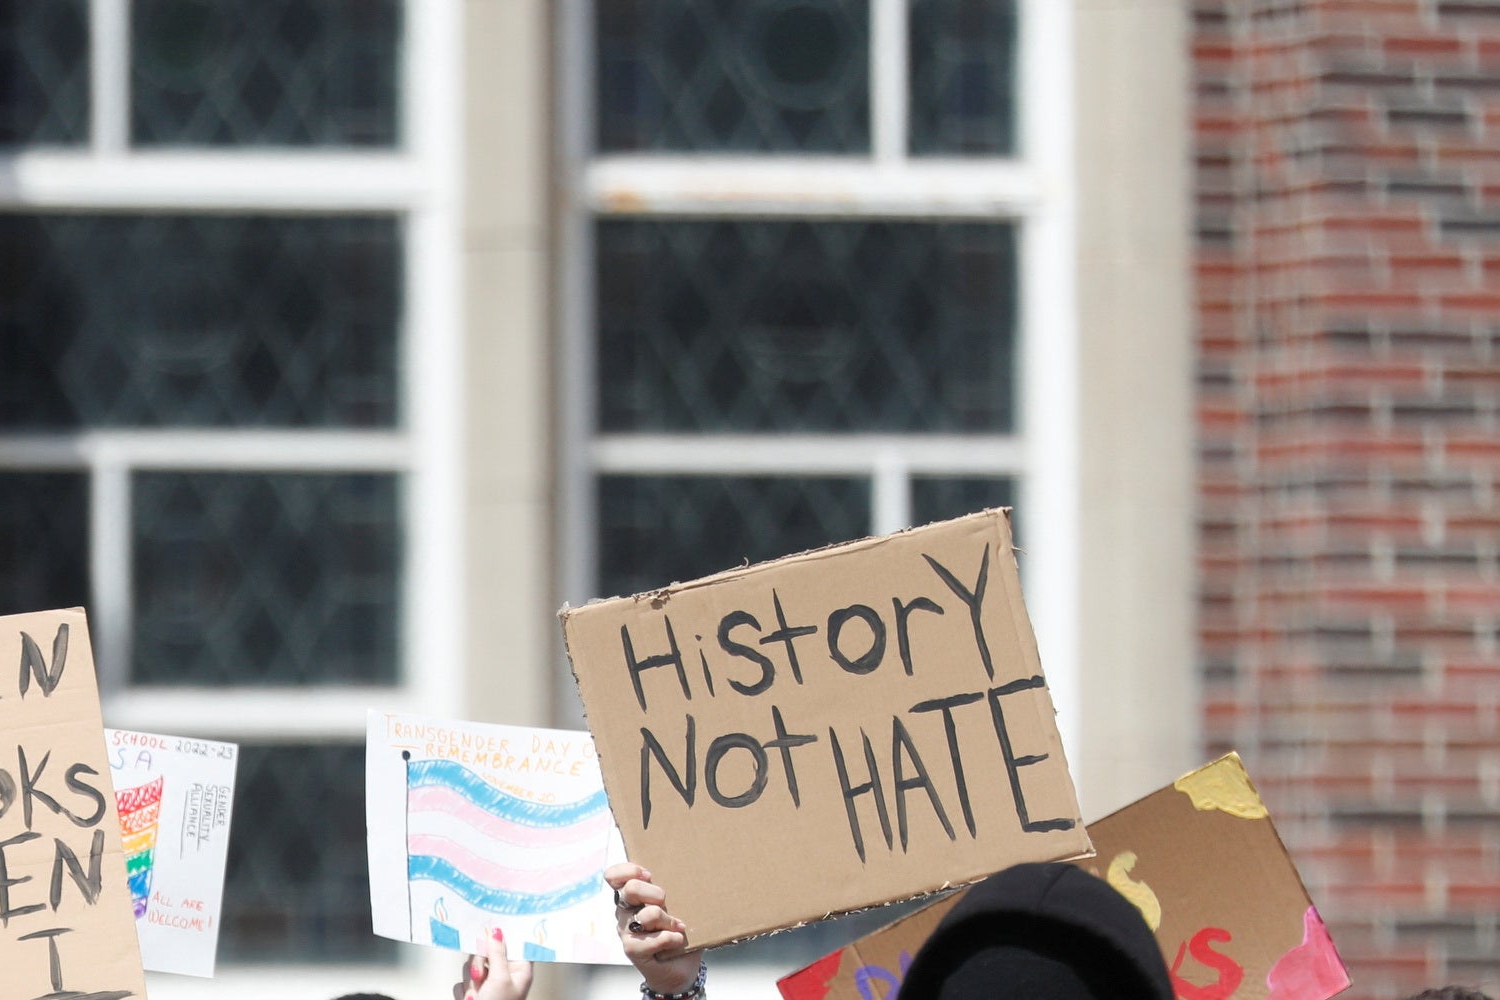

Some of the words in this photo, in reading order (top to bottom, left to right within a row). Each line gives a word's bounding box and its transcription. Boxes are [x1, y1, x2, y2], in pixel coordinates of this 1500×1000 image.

[112, 731, 168, 750] SCHOOL
[384, 714, 510, 753] TRANSGENDER
[532, 734, 571, 757] DAY
[425, 742, 584, 777] REMEMBRANCE
[828, 675, 1077, 864] HATE
[186, 782, 202, 838] ALLIANCE
[200, 783, 217, 842] SEXUALITY
[216, 786, 231, 826] GENDER
[152, 891, 173, 908] ALL
[181, 898, 205, 911] ARE
